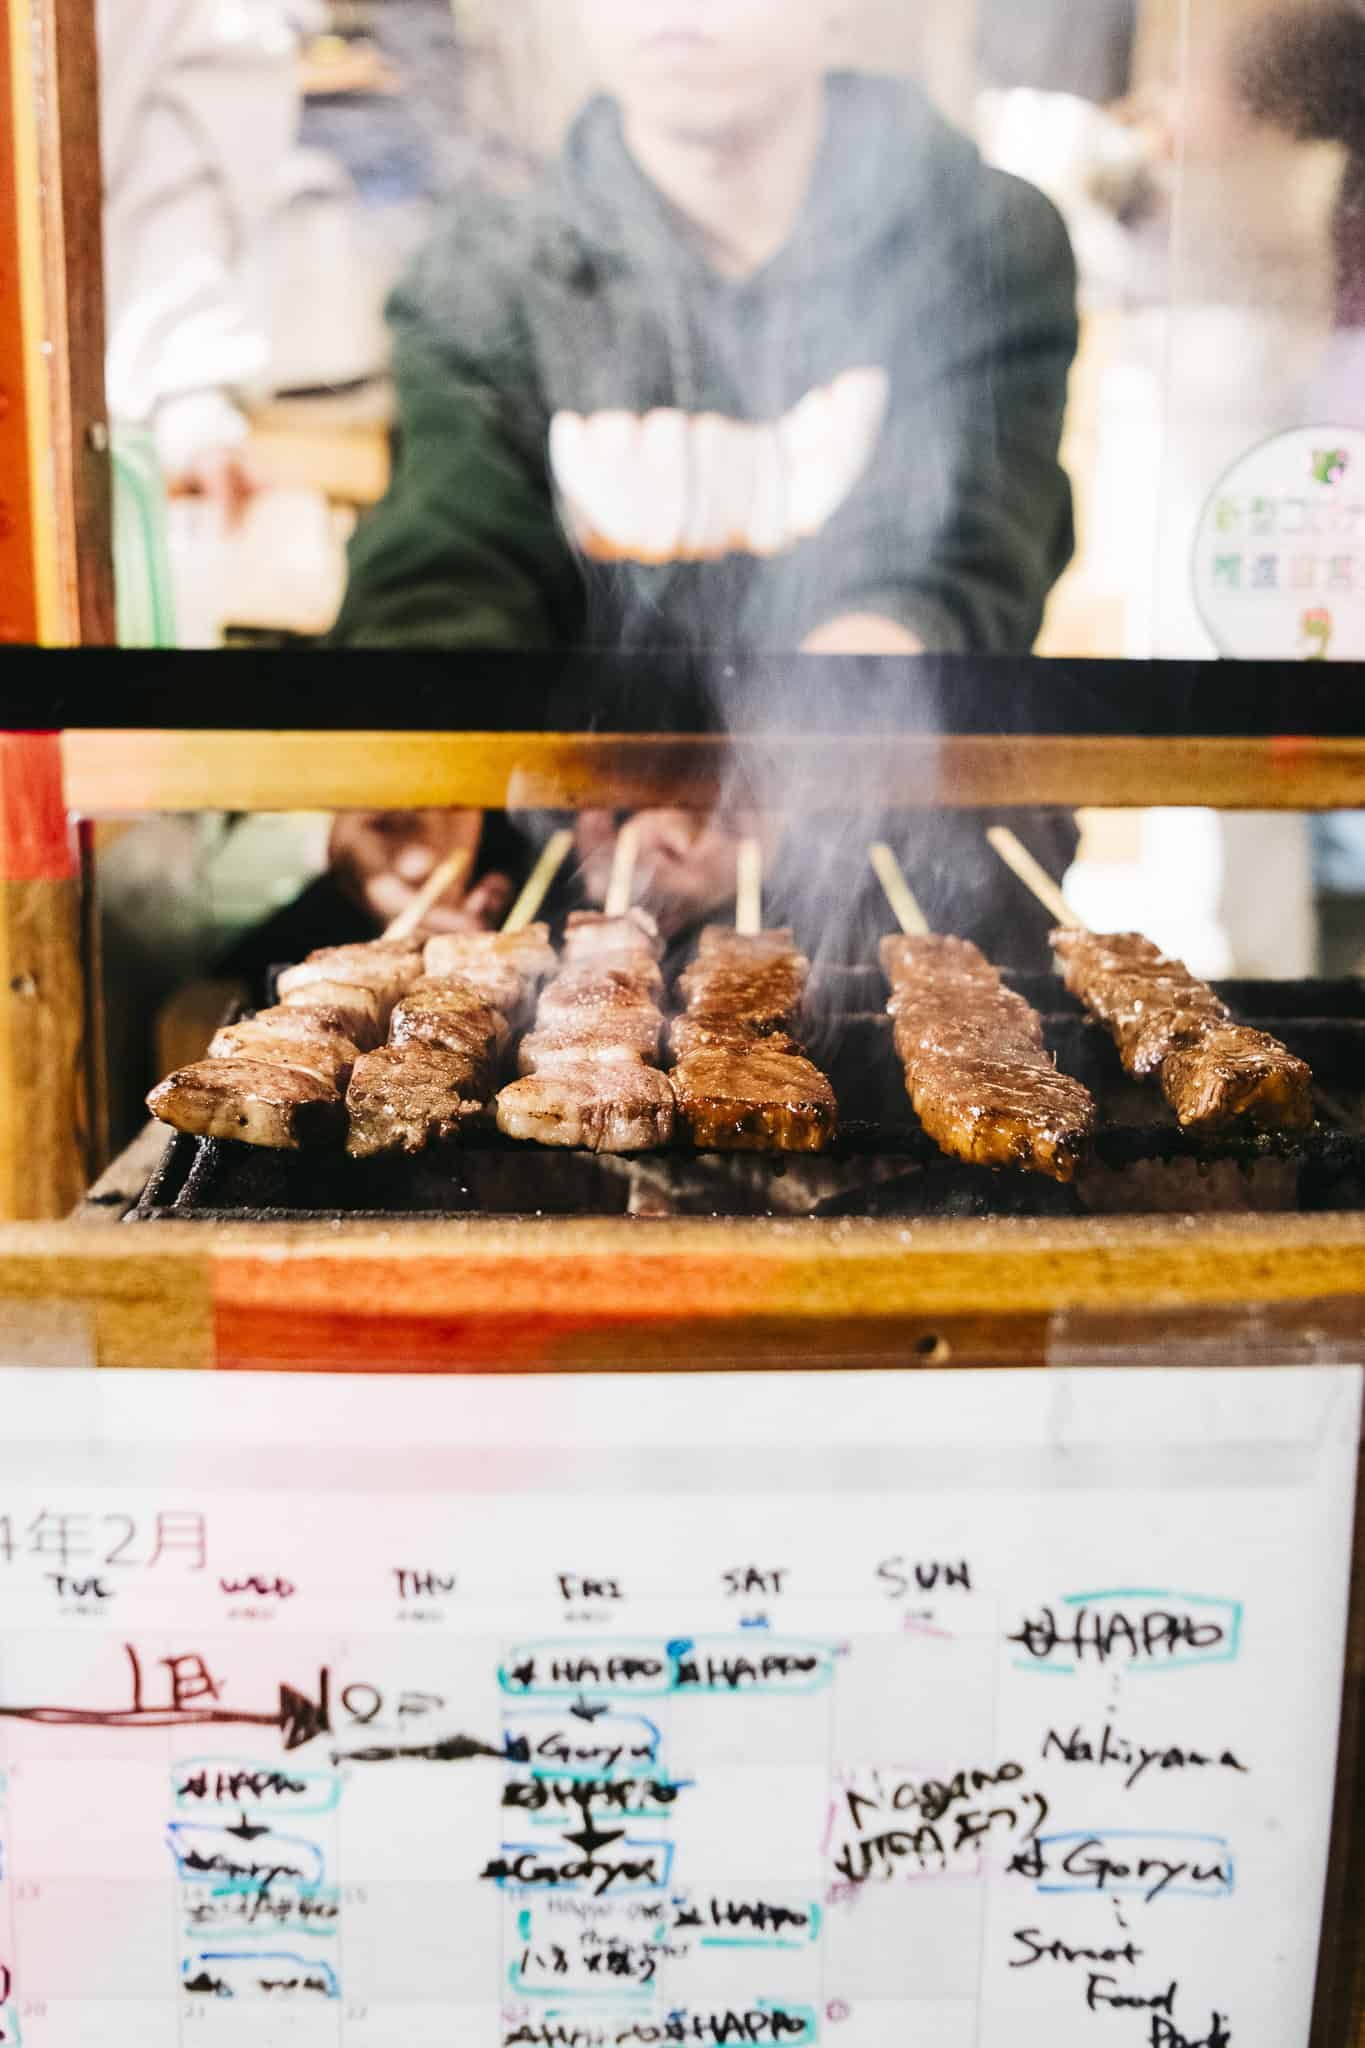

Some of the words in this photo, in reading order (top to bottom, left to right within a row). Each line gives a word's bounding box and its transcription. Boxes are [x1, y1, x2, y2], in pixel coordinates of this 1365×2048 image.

[722, 1567, 788, 1595] SAT
[877, 1557, 974, 1597] SUN
[1063, 1841, 1229, 1902] Goryu
